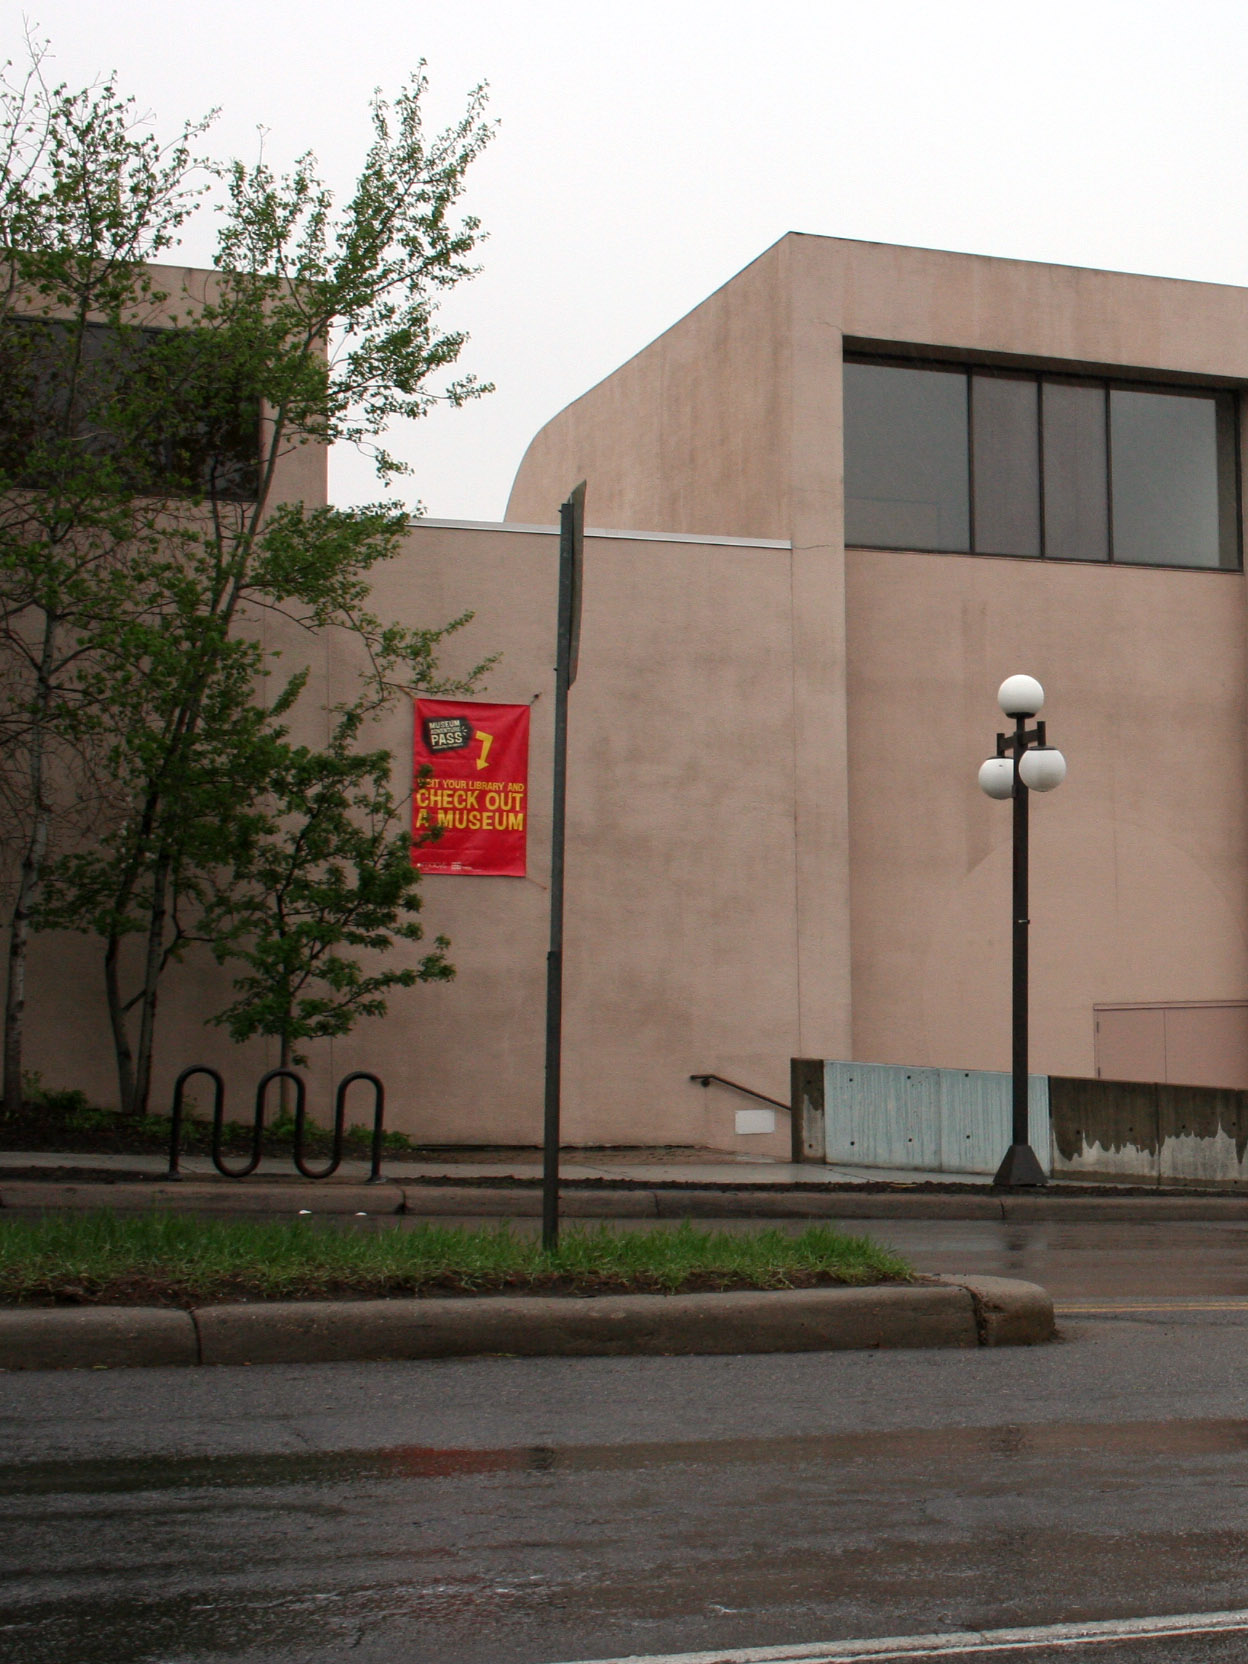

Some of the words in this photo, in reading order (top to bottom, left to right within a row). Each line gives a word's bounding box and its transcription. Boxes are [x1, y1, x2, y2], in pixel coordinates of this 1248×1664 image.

[429, 720, 460, 729] MUSEUM
[431, 732, 463, 746] PASS
[418, 778, 440, 788] SIT
[443, 779, 467, 789] YOUR
[469, 781, 504, 791] LIBRARY
[507, 783, 525, 792] AND
[416, 789, 480, 809] CHECK
[485, 792, 524, 811] OUT
[416, 809, 429, 828] A
[437, 810, 524, 831] MUSEUM
